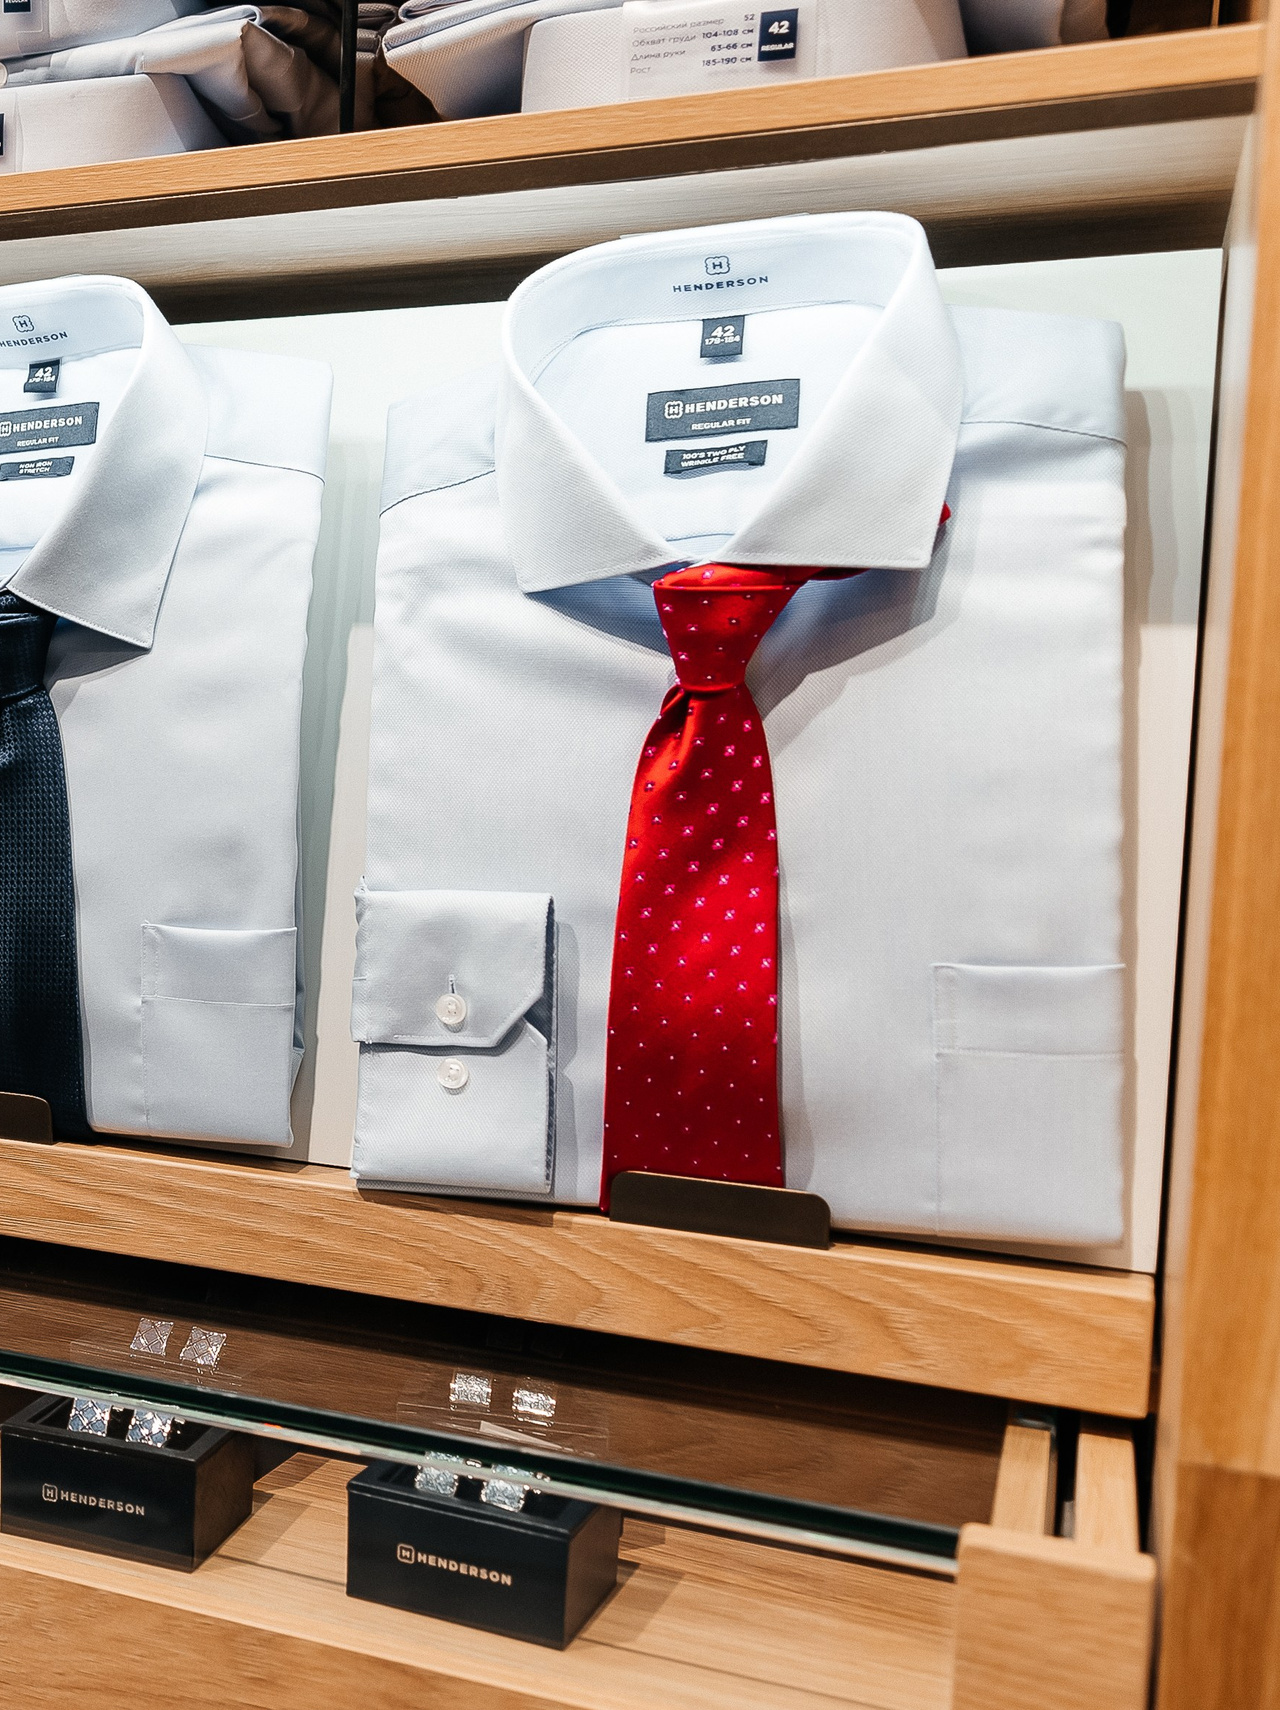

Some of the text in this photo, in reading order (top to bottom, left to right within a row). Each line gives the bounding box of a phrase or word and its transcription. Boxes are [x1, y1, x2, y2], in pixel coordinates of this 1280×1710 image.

[633, 22, 687, 33] Российский
[744, 13, 755, 21] 52
[768, 20, 790, 34] 42
[632, 37, 665, 47] Обхват
[668, 34, 696, 44] груди
[702, 29, 739, 39] 104-108
[631, 53, 661, 61] Длина
[710, 43, 738, 52] 63-66
[630, 66, 651, 74] Рост
[702, 57, 738, 67] 185-190
[673, 275, 769, 293] HENDERSON
[0, 331, 69, 348] HENDERSON
[710, 325, 735, 338] 42
[34, 366, 53, 378] 42
[685, 394, 784, 414] HENDERSON
[12, 416, 83, 433] HENDERSON
[691, 417, 752, 430] REGULAR FIT
[17, 436, 60, 447] REGULAR FIT
[681, 452, 744, 467] WRINKLE FREE
[682, 445, 746, 460] 100'S TWO PLY
[60, 1489, 145, 1516] HENDERSON
[417, 1551, 512, 1586] HENDERSON
